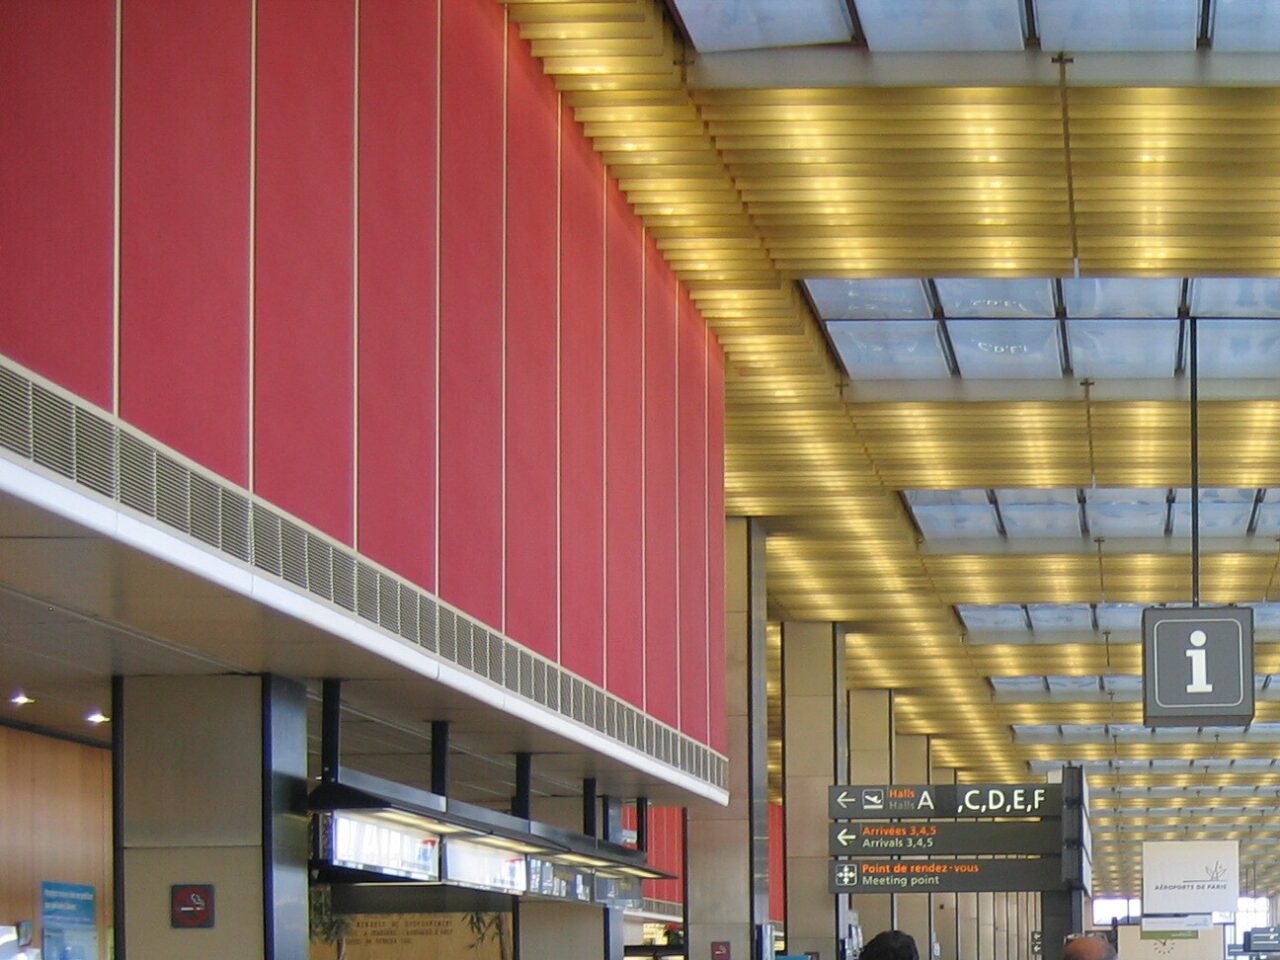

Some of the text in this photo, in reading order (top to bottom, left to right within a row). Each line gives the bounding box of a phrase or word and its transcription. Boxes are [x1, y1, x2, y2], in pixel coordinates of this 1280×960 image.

[889, 788, 915, 798] Halls
[889, 800, 915, 810] Halls
[917, 790, 935, 810] A
[910, 826, 937, 836] 3,4,5
[862, 838, 934, 848] Arrivals 3,4,5
[862, 864, 979, 873] Point de rendez-vous
[862, 875, 940, 887] Meeting point
